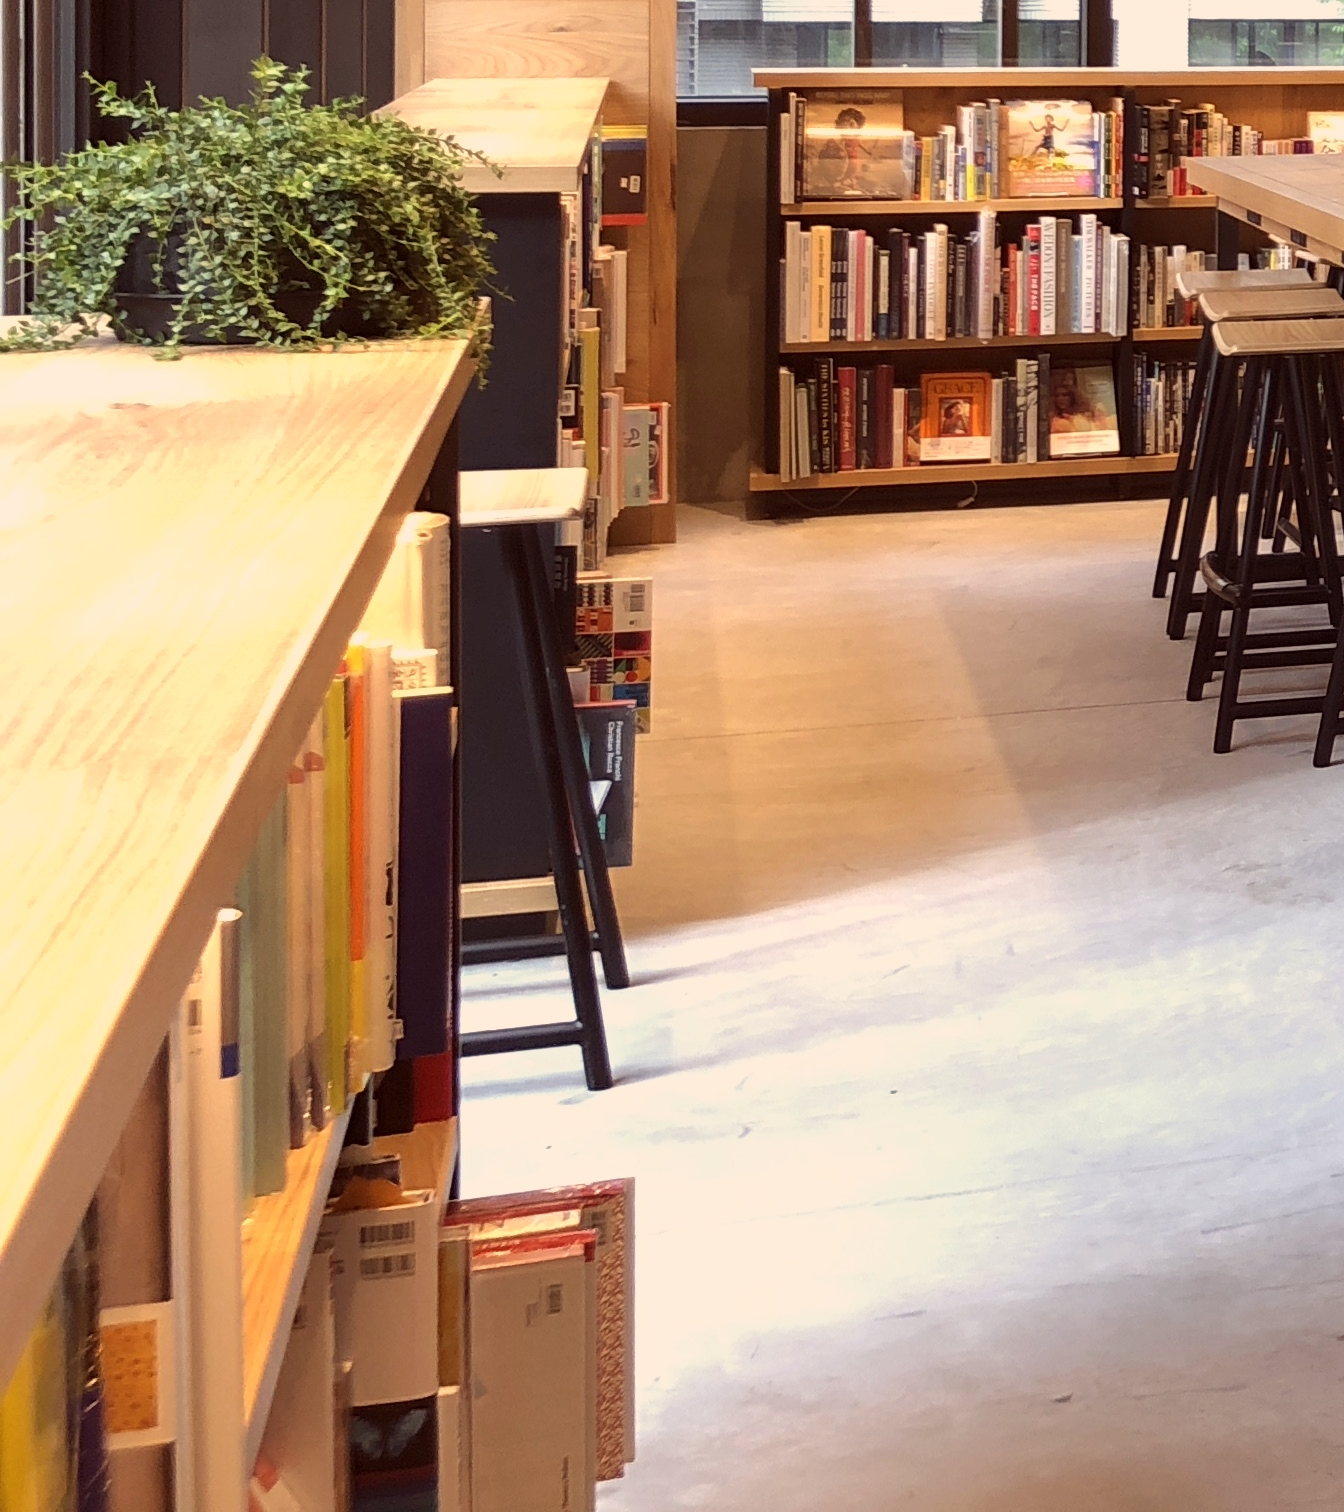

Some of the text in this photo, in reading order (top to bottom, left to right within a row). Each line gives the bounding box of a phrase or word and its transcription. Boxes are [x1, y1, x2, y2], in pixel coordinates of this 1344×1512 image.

[1030, 273, 1038, 311] THE FACE
[1043, 270, 1054, 319] FASHION
